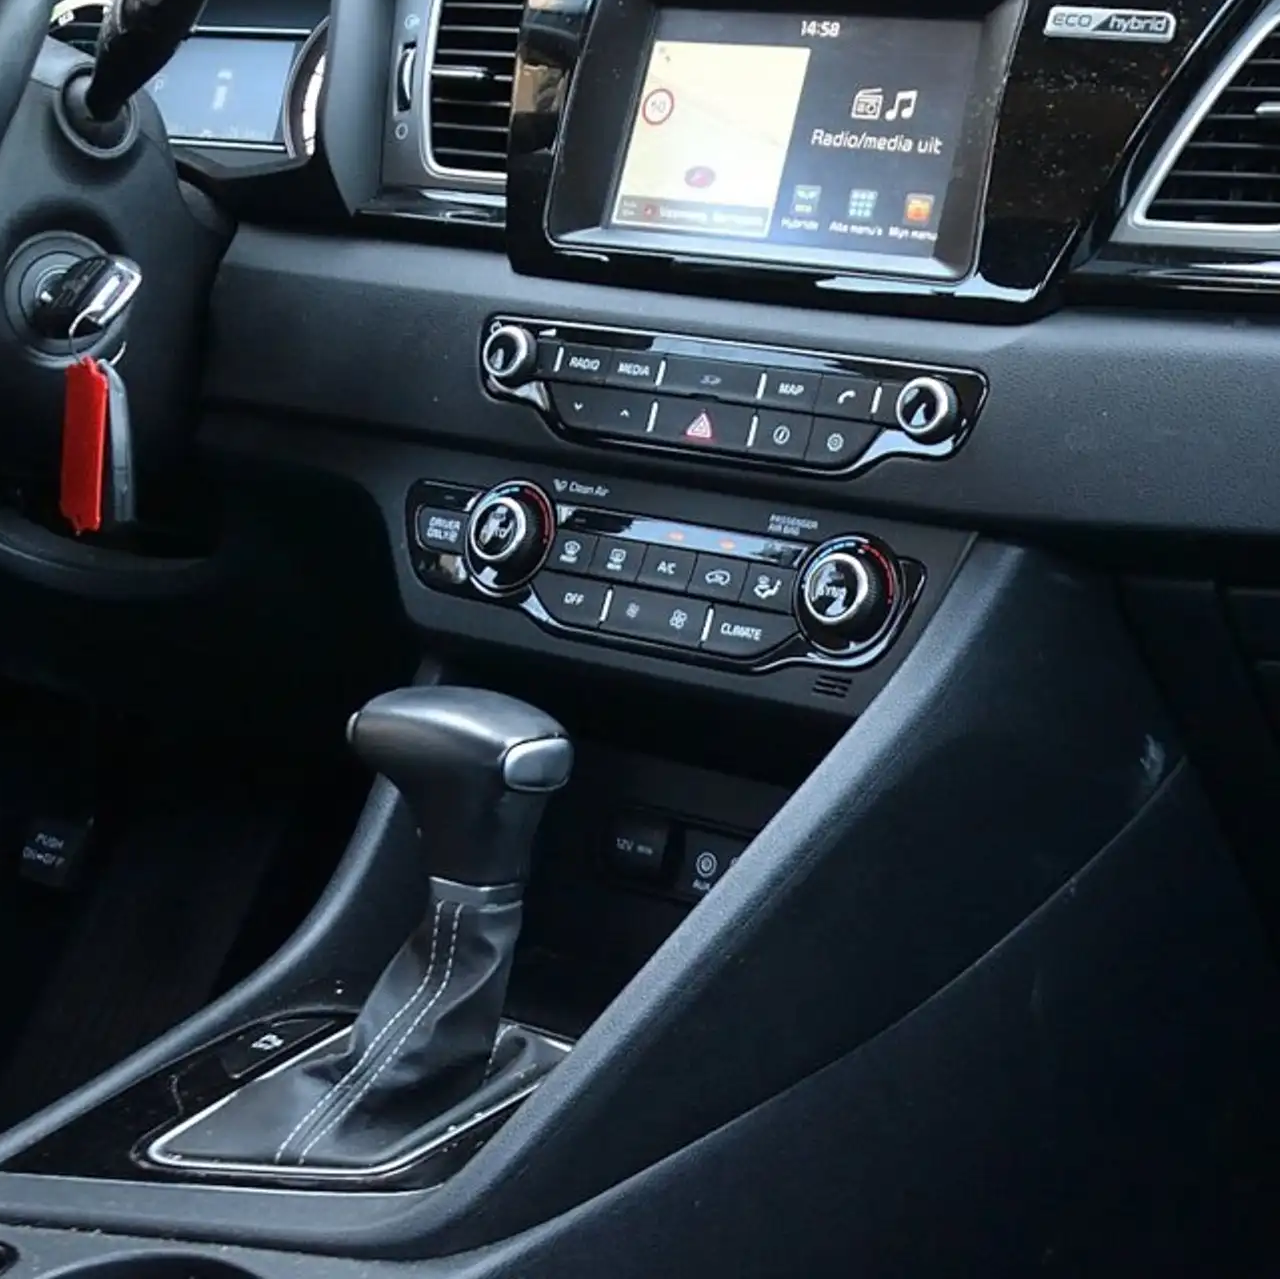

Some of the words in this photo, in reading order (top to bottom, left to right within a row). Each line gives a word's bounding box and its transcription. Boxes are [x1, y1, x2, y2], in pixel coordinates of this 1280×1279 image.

[800, 20, 841, 38] 14:58
[1108, 14, 1168, 33] hybrid
[810, 128, 914, 154] Radio/media
[917, 135, 944, 156] uit
[568, 356, 601, 371] RADIO
[618, 362, 651, 377] MEDIA
[777, 382, 805, 396] MAP
[656, 560, 677, 575] A/C
[563, 592, 585, 606] OFF
[720, 622, 763, 641] CLIMATE
